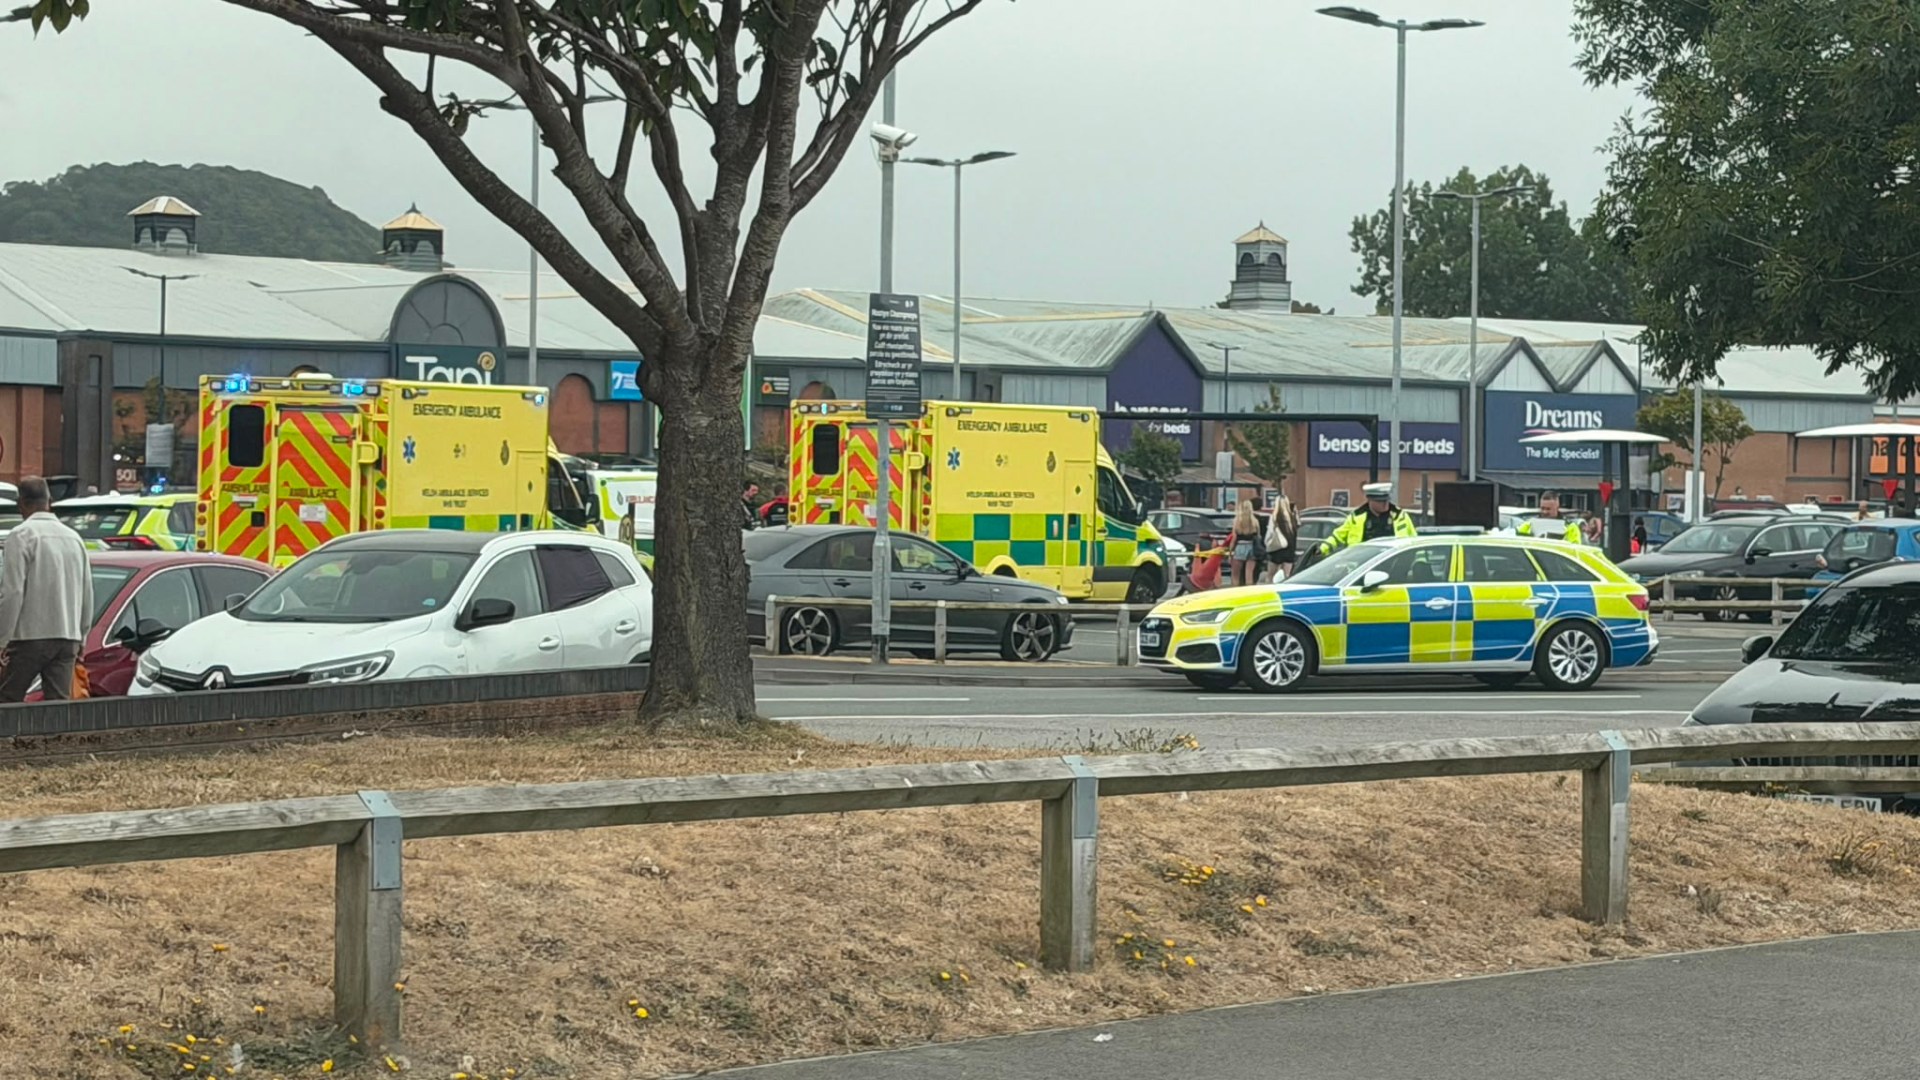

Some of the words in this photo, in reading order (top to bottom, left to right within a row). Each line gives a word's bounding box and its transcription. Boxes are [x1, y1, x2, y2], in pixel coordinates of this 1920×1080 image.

[413, 403, 457, 417] EMERGENCY
[459, 405, 502, 419] AMBULANCE
[1525, 400, 1603, 429] Dreams
[957, 419, 1002, 432] EMERGENCY
[1003, 421, 1048, 434] AMBULANCE
[1163, 422, 1191, 434] beds
[1413, 438, 1455, 454] beds
[1525, 446, 1541, 459] The
[1542, 447, 1560, 459] Bed
[1561, 447, 1600, 461] Specialist
